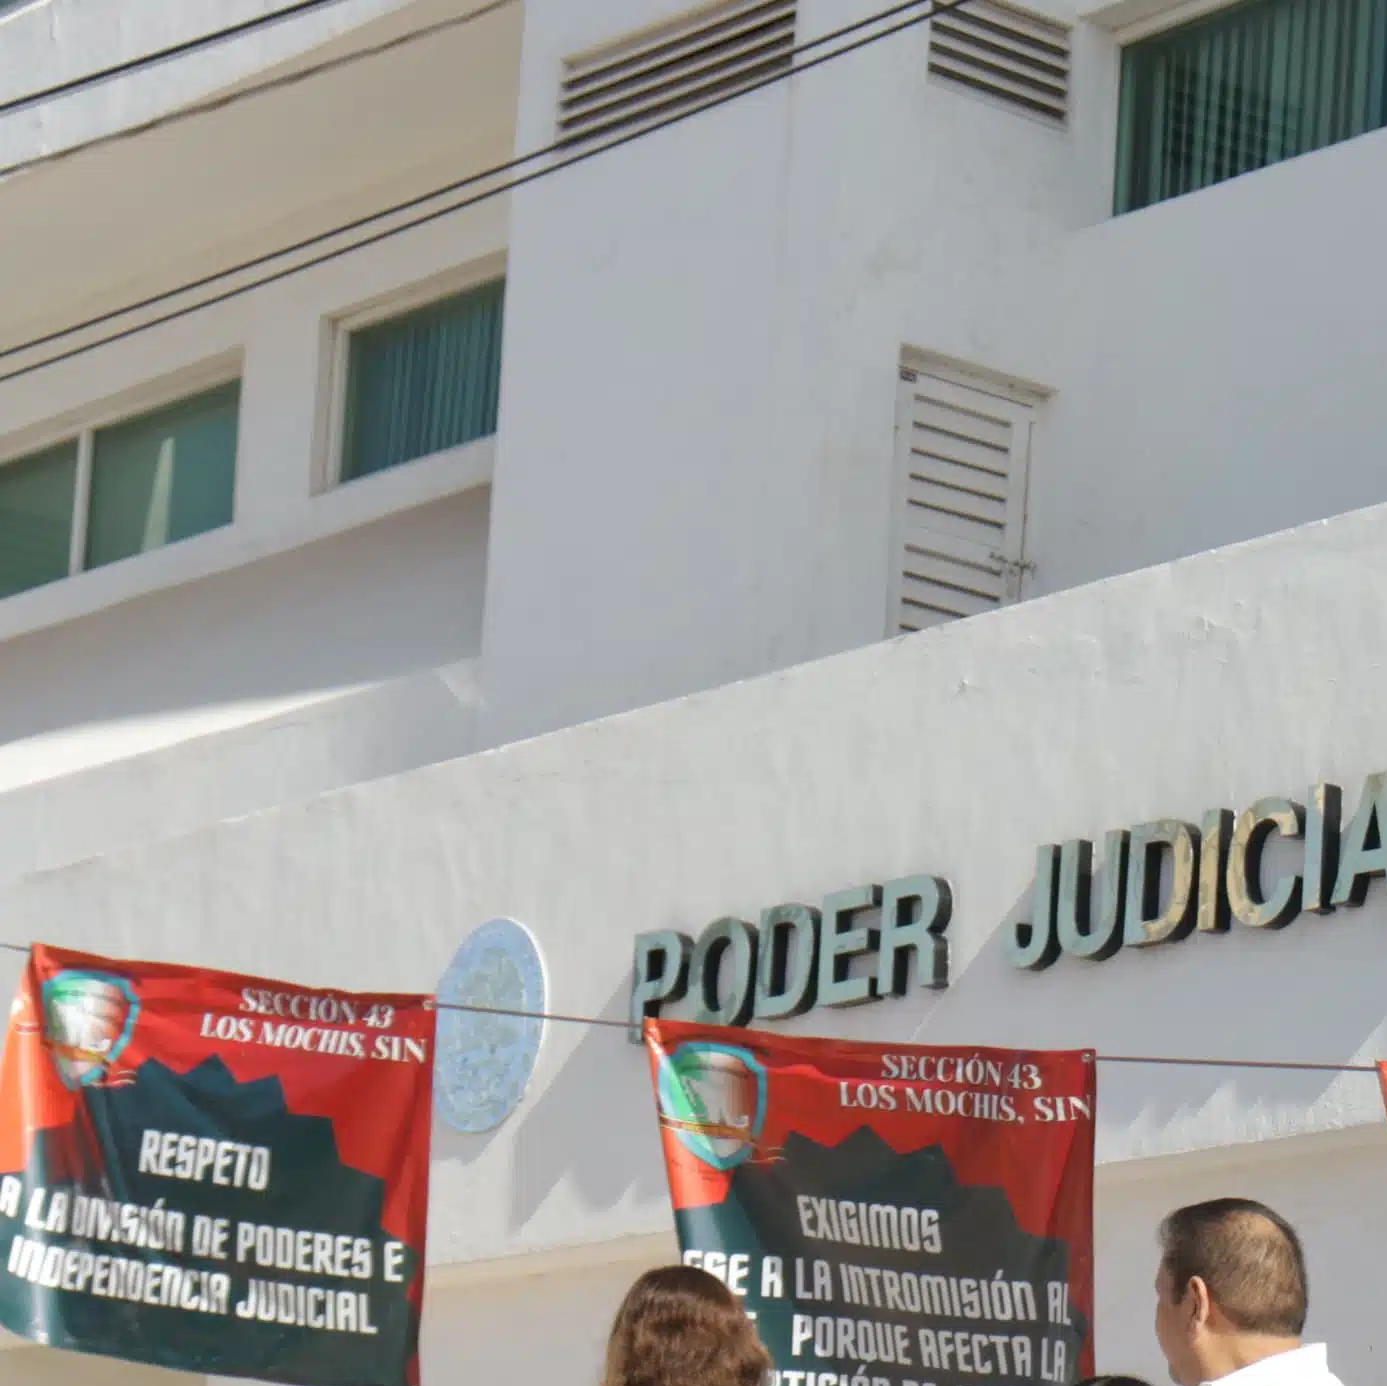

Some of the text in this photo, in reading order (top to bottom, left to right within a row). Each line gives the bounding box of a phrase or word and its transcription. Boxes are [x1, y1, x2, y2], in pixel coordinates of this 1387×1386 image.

[627, 874, 953, 1044] PODER
[199, 1011, 428, 1064] LOS MOCHIS, SIN
[239, 985, 395, 1029] SECCIÓN 43
[839, 1081, 1092, 1124] LOS MOCHIS, SIN
[881, 1051, 1043, 1091] SECCIÓN 43
[138, 1128, 272, 1191] RESPETO
[0, 1175, 22, 1218] A
[24, 1187, 69, 1233] LA
[193, 1215, 230, 1259] DE
[236, 1223, 374, 1281] PODERES
[383, 1241, 405, 1282] E
[797, 1194, 943, 1255] EXIGIMOS
[8, 1235, 378, 1335] INDEPENDENCIA JUDICIAL
[760, 1256, 783, 1298] A
[796, 1257, 832, 1302] LA
[839, 1270, 1037, 1321] INTROMISIÓN
[1047, 1280, 1073, 1326] AL
[791, 1314, 1069, 1383] PORQUE AFECTA LA
